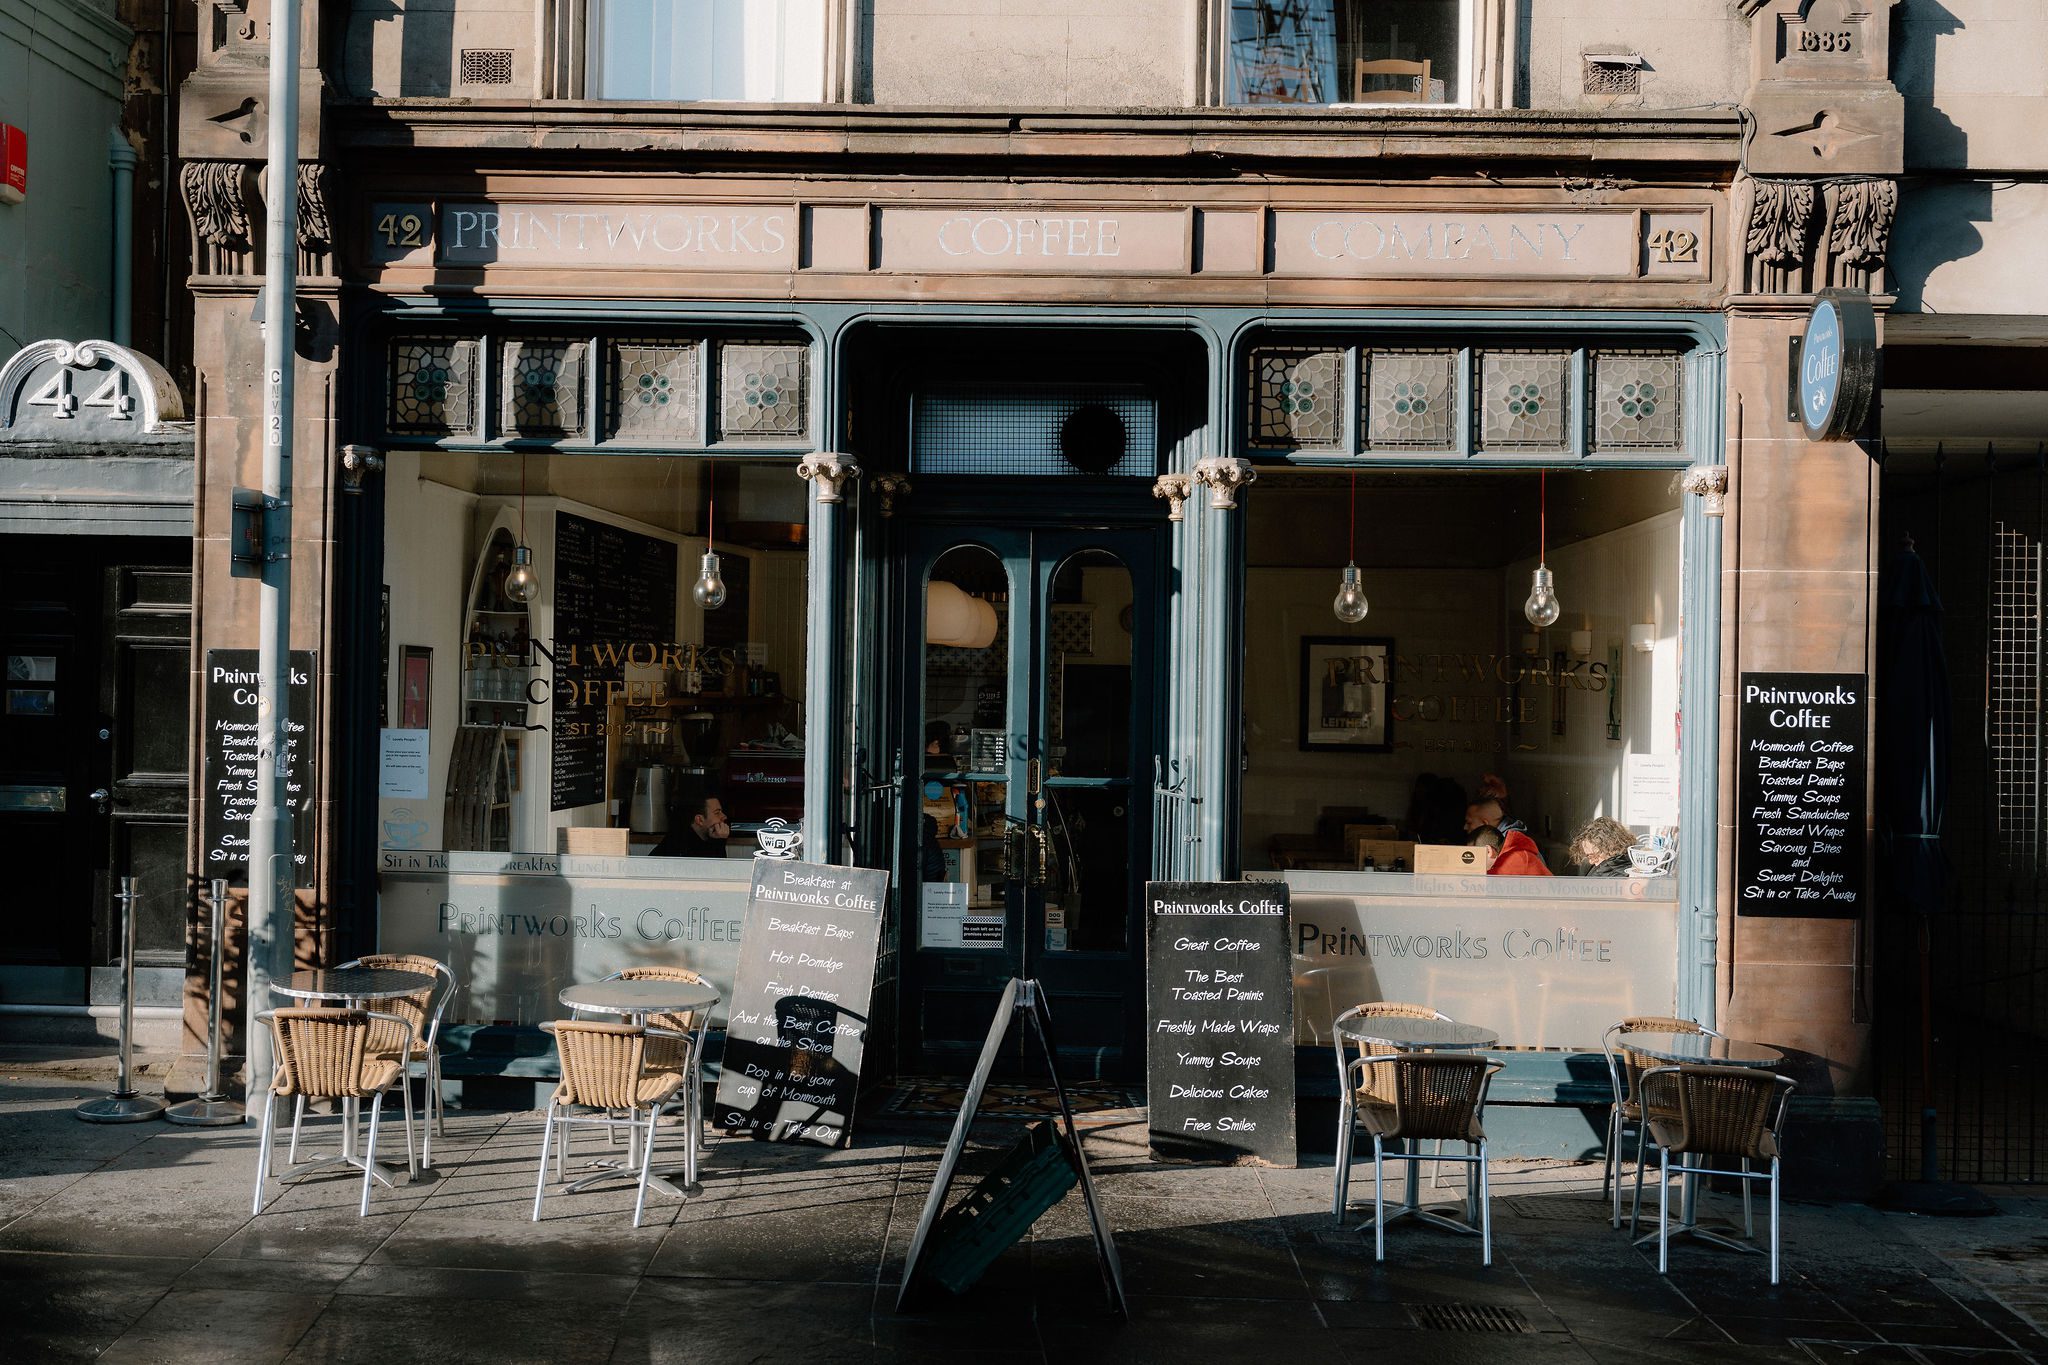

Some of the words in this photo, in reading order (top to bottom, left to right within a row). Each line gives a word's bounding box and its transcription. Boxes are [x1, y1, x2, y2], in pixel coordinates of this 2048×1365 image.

[1797, 31, 1850, 52] 1886
[378, 213, 423, 247] 42
[451, 210, 786, 254] PRINTWORKS
[938, 217, 1121, 257] COFFEE
[1311, 219, 1585, 261] COMPANY
[1648, 227, 1698, 263] 42
[27, 368, 130, 420] 44
[213, 667, 308, 685] Printks
[1326, 655, 1609, 692] PRINTWORKS
[215, 719, 259, 731] Monmout
[1769, 709, 1831, 728] Coffee
[596, 721, 634, 737] 2012
[1750, 739, 1805, 752] Monmouth
[1810, 740, 1854, 753] Coffee
[225, 765, 256, 778] Yummy
[1758, 756, 1811, 769] Breakfast
[1815, 757, 1845, 773] Baps
[217, 779, 242, 790] Fresh
[1758, 773, 1804, 786] Toasted
[1807, 773, 1845, 787] Panini's
[1762, 790, 1798, 805] Yummy
[1802, 790, 1841, 806] Soups
[1752, 807, 1782, 819] Fresh
[1786, 807, 1850, 820] Sandwiches
[221, 834, 250, 846] Swee
[1757, 823, 1805, 836] Toasted
[1808, 824, 1845, 840] Wraps
[209, 849, 228, 861] Sit
[229, 852, 237, 861] in
[1759, 840, 1807, 855] Savoury
[1812, 841, 1842, 853] Bites
[384, 855, 402, 868] Sit
[427, 856, 449, 869] Tak
[1791, 856, 1811, 868] and
[783, 871, 836, 889] Breakfast
[841, 880, 852, 890] at
[1757, 869, 1796, 882] Sweet
[1800, 870, 1844, 886] Delights
[1743, 885, 1765, 898] Sit
[1766, 888, 1776, 899] in
[1777, 890, 1791, 899] or
[1793, 887, 1820, 899] Take
[1822, 887, 1857, 902] Away
[1239, 899, 1284, 914] Coffee
[767, 917, 821, 935] Breakfast
[824, 924, 854, 942] Baps
[1174, 937, 1209, 951] Great
[1214, 937, 1260, 952] Coffee
[769, 950, 795, 965] Hot
[797, 952, 844, 974] Porridge
[1185, 969, 1209, 983] The
[1214, 969, 1244, 984] Best
[764, 981, 794, 997] Fresh
[798, 985, 840, 1003] Pastries
[1172, 987, 1223, 1001] Toasted
[1226, 987, 1264, 1001] Paninis
[732, 1010, 760, 1025] And
[763, 1014, 779, 1027] the
[783, 1015, 812, 1032] Best
[816, 1020, 861, 1038] Coffee
[1156, 1019, 1197, 1036] Freshly
[1201, 1019, 1236, 1033] Made
[1240, 1019, 1280, 1037] Wraps
[756, 1036, 770, 1046] on
[775, 1035, 792, 1048] the
[795, 1037, 833, 1054] Shore
[1176, 1052, 1215, 1068] Yummy
[1219, 1051, 1262, 1069] Soups
[744, 1063, 770, 1081] Pop
[775, 1069, 784, 1081] in
[787, 1070, 804, 1084] for
[807, 1076, 835, 1087] your
[737, 1085, 757, 1098] cup
[761, 1086, 777, 1098] of
[780, 1087, 837, 1106] Monmouth
[1169, 1084, 1224, 1099] Delicious
[1229, 1084, 1269, 1099] Cakes
[724, 1112, 746, 1126] Sit
[750, 1116, 759, 1128] in
[763, 1122, 777, 1131] or
[784, 1119, 811, 1137] Take
[815, 1125, 840, 1140] Out
[1183, 1117, 1212, 1131] Free
[1216, 1117, 1257, 1132] Smiles
